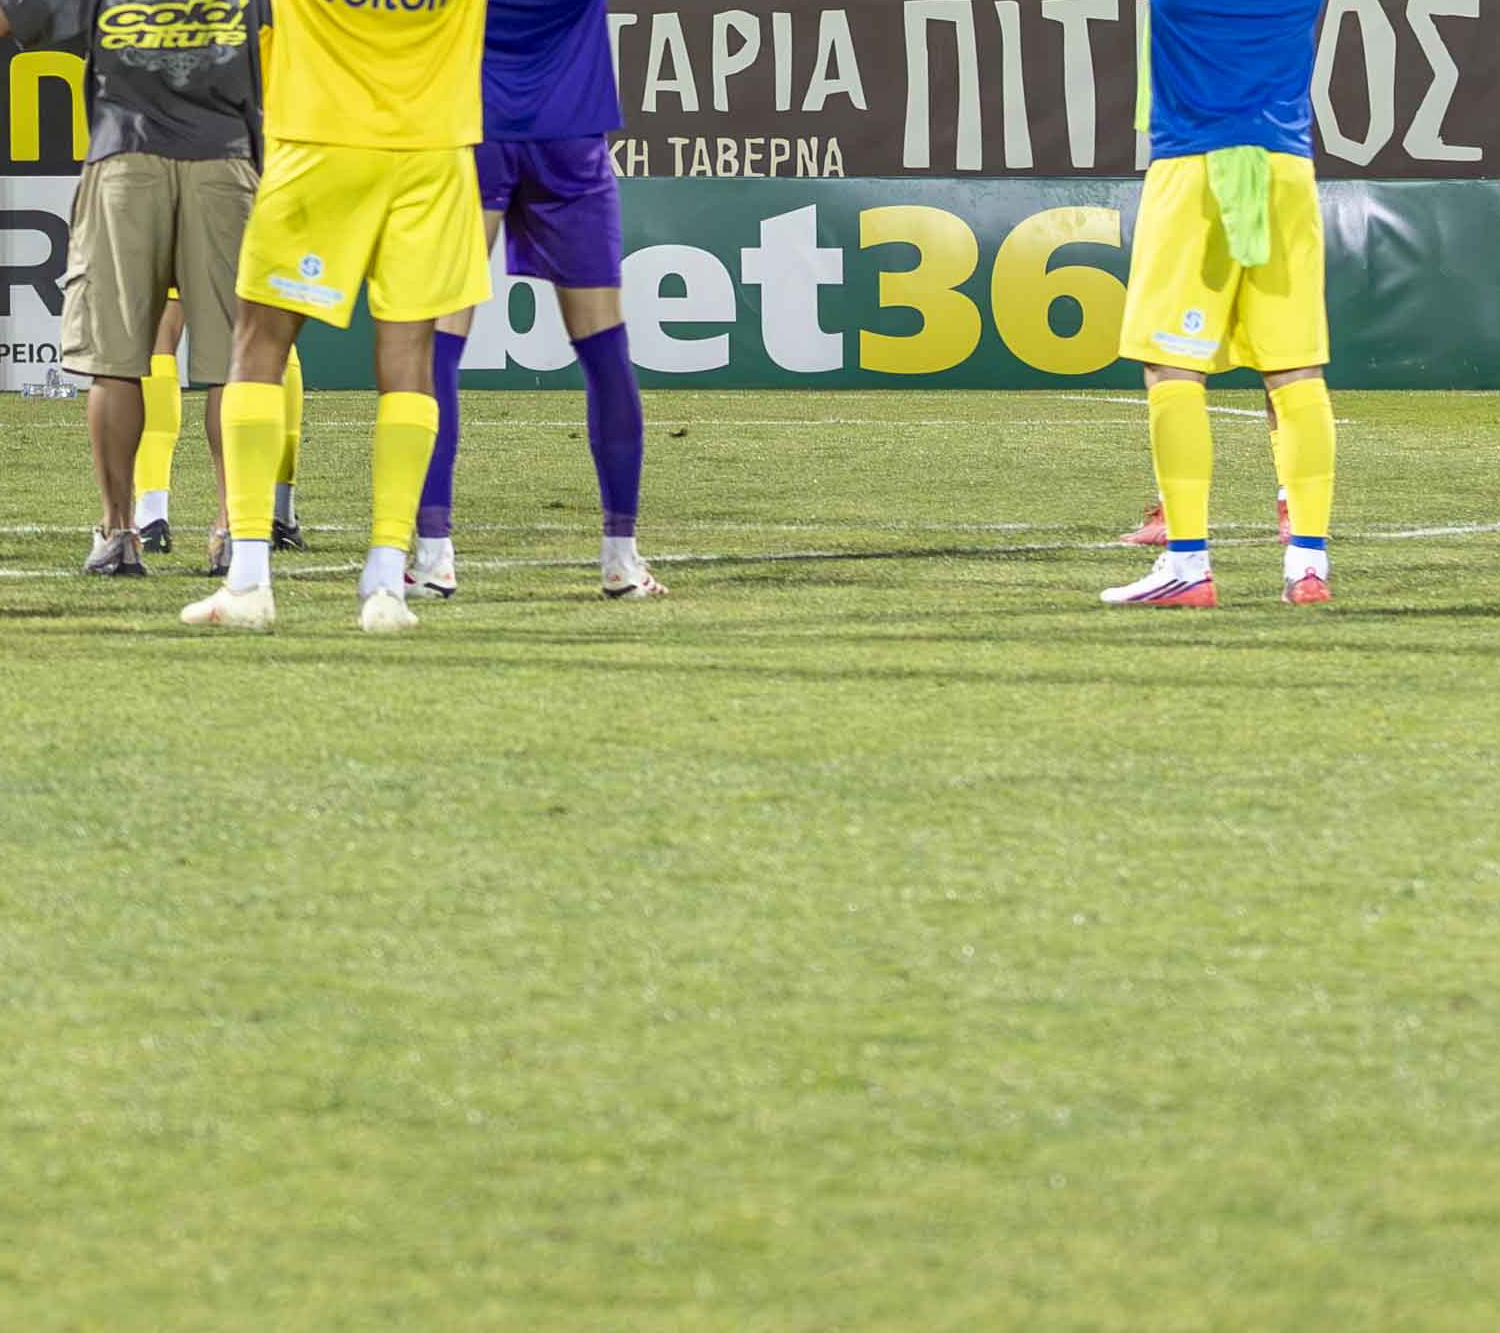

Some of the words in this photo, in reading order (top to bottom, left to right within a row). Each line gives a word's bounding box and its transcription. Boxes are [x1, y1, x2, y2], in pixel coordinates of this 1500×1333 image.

[605, 7, 868, 113] ΤΑΡΙΑ
[668, 137, 845, 178] ΤΑΒΕΡΝΑ
[458, 203, 1127, 377] bet36
